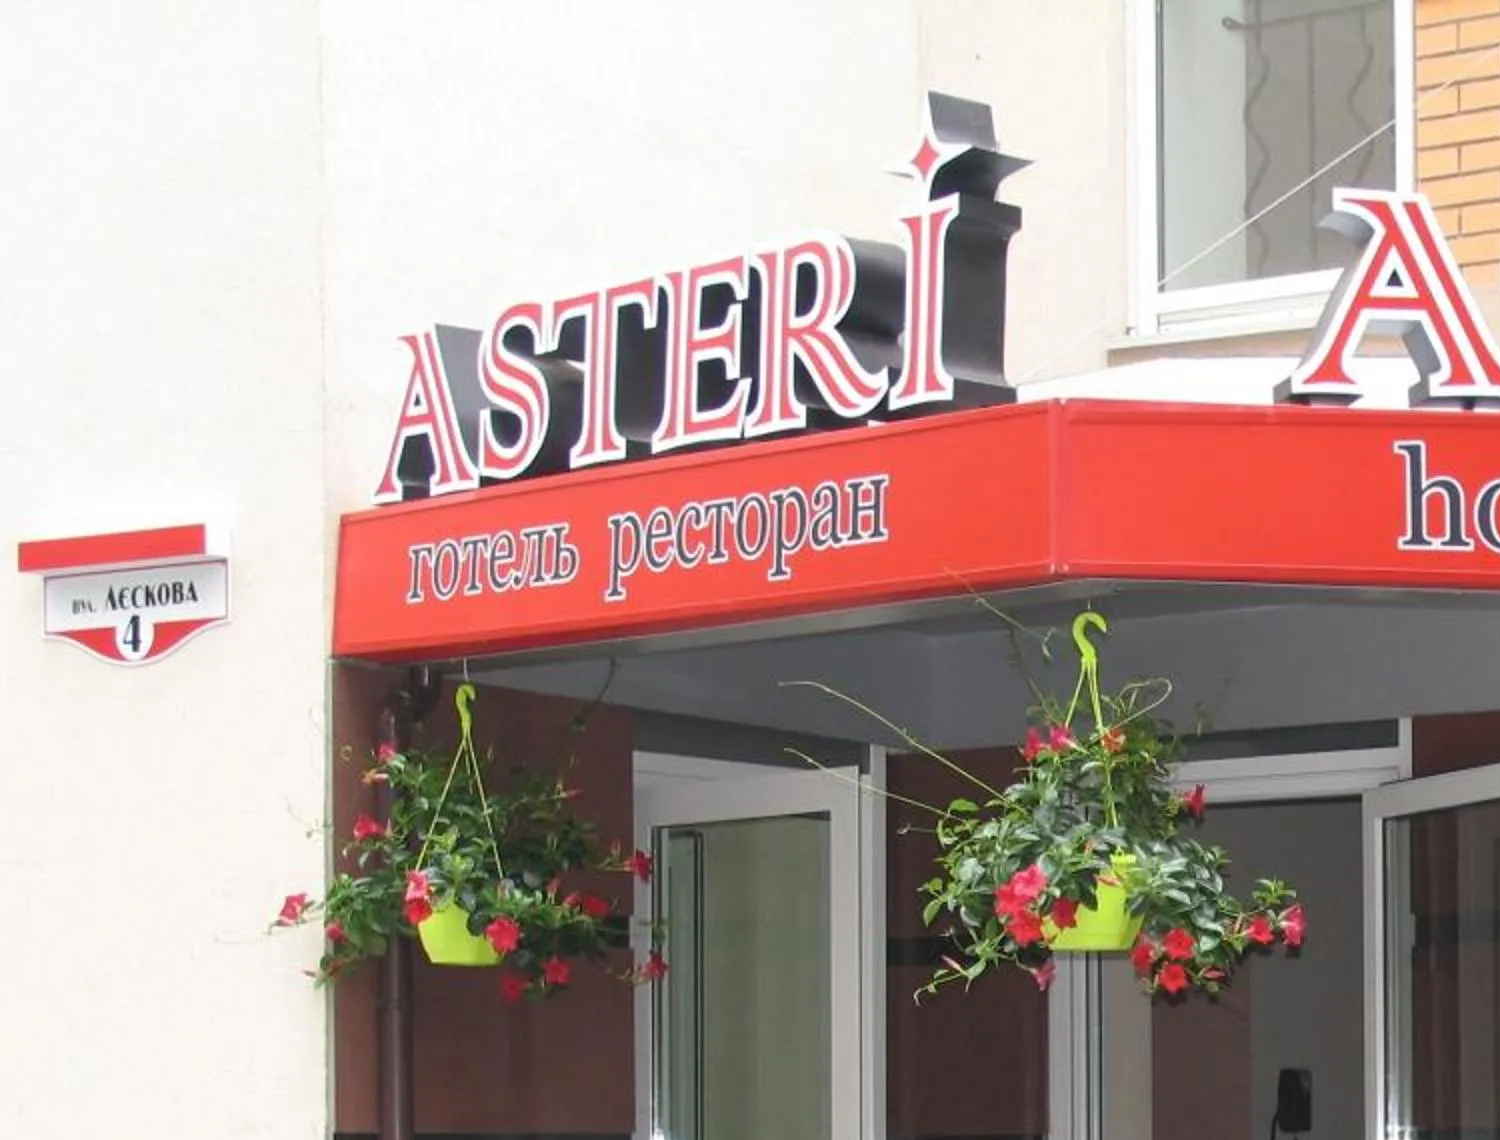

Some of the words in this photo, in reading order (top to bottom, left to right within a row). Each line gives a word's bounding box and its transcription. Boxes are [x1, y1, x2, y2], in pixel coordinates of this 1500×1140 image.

[406, 522, 580, 606] готель
[604, 474, 892, 602] ресторан
[122, 614, 142, 653] 4
